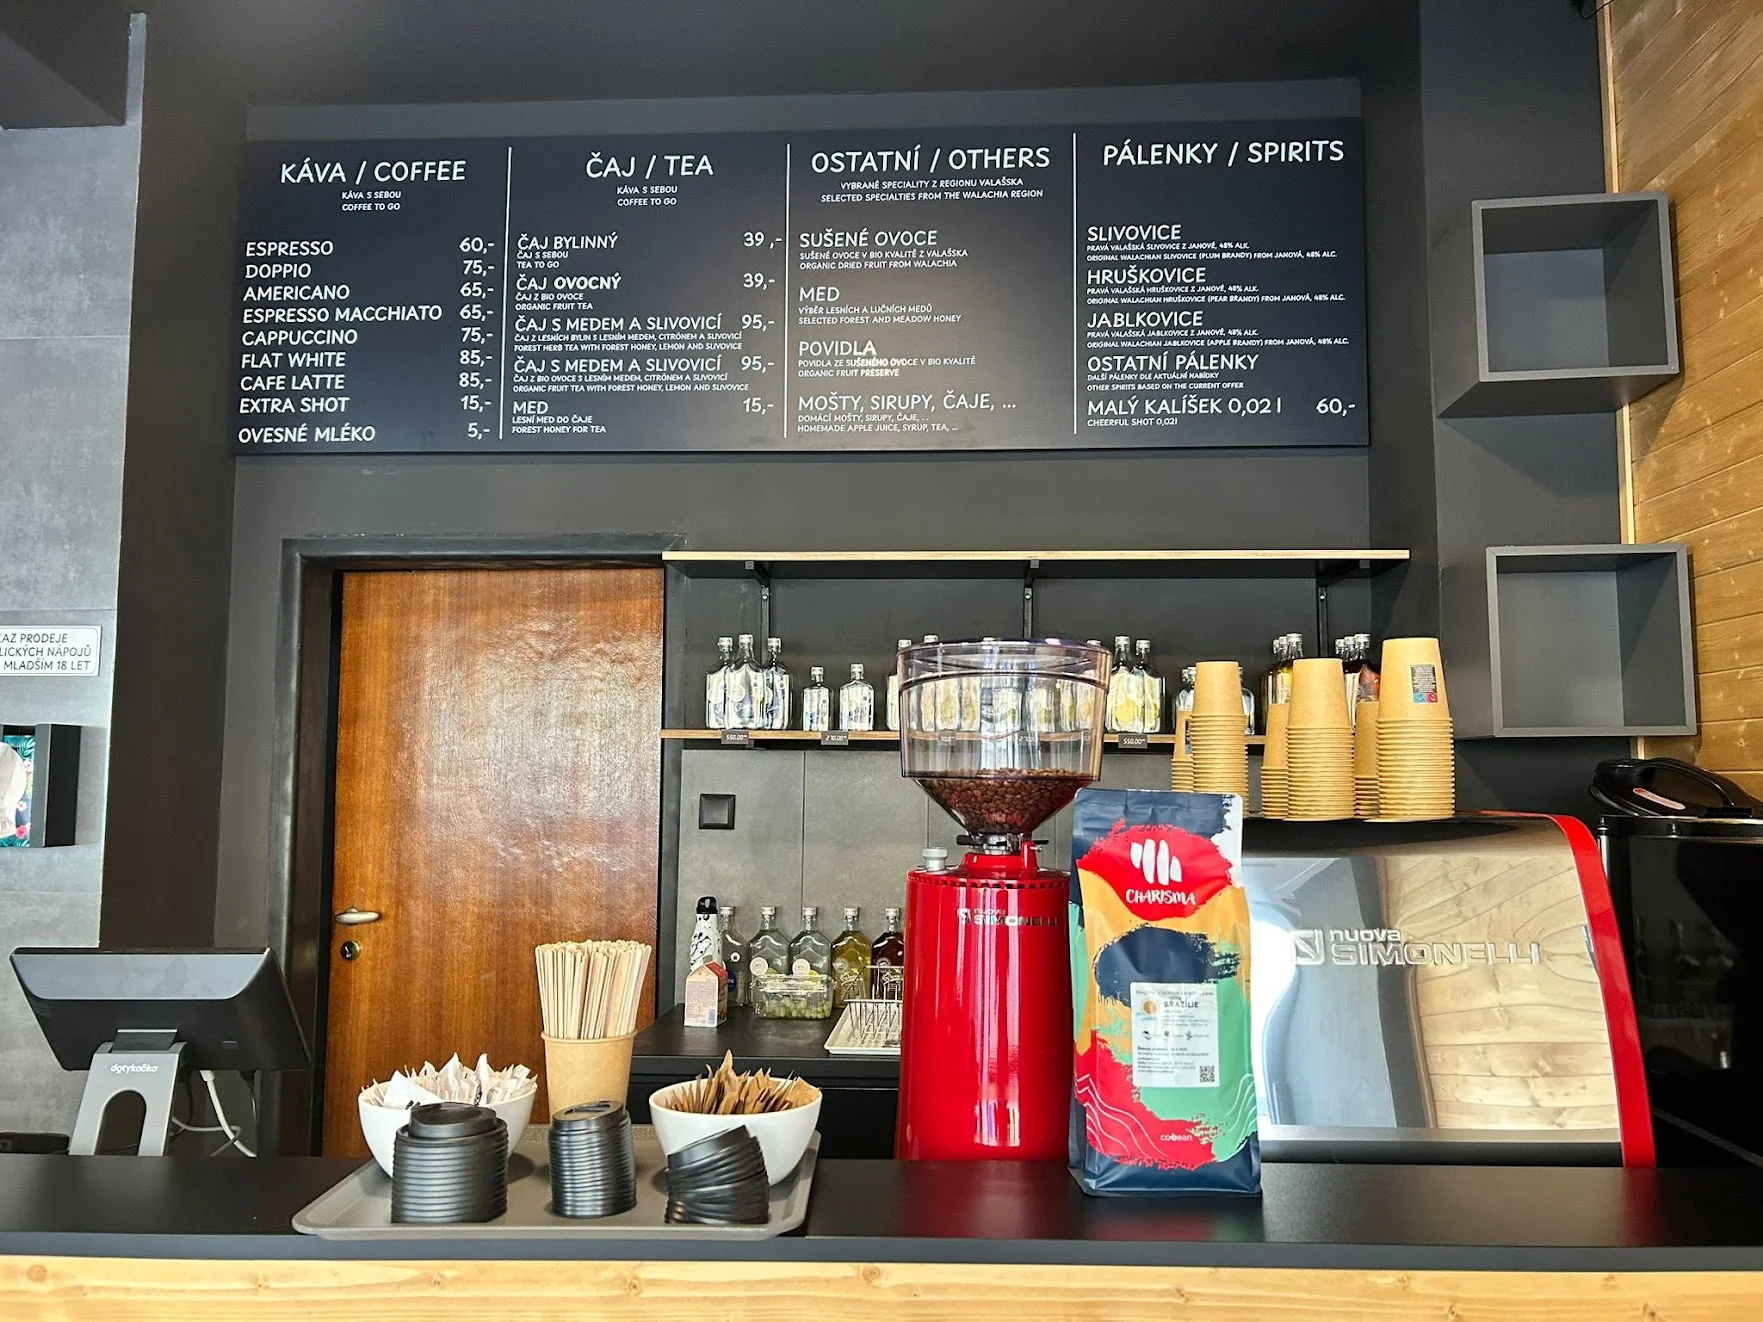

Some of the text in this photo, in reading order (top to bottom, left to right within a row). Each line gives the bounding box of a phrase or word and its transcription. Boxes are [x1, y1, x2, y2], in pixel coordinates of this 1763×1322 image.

[812, 145, 1050, 173] OSTATNÍ / OTHERS
[1104, 139, 1344, 166] PÁLENKY / SPIRITS
[281, 157, 466, 185] KÁVA / COFFEE
[586, 152, 713, 179] ČAJ / TEA
[617, 185, 678, 194] KÁVA S SEBOU
[841, 177, 1023, 190] VYBRANÉ SPECIALITY Z REGIONU VALAŠSKA
[342, 190, 401, 199] KÁVA S SEBOU
[617, 198, 648, 206] COFFEE
[663, 197, 677, 205] GO
[821, 190, 1043, 202] SELECTED SPECIALTIES FROM THE WALACHIA REGION
[342, 203, 372, 211] COFFEE
[518, 233, 548, 250] ČAJ
[553, 232, 618, 249] BYLINNÝ
[800, 227, 937, 248] SUŠENÉ OVOCE
[1088, 224, 1181, 241] SLIVOVICE
[246, 237, 495, 257] ESPRESSO 60,-
[517, 250, 568, 259] ČAJ S SEBOU
[245, 260, 495, 278] DOPPIO 75,-
[516, 261, 532, 269] TEA
[799, 260, 957, 270] ORGANIC DRIED FRUIT FROM WALACHIA
[516, 272, 775, 291] ČAJ OVOCNÝ 39,-
[1088, 265, 1206, 285] HRUŠKOVICE
[243, 282, 494, 301] AMERICANO 65,-
[799, 286, 840, 302] MED
[243, 304, 494, 323] ESPRESSO MACCHIATO 65,-
[515, 303, 551, 311] ORGANIC
[577, 302, 593, 310] TEA
[515, 312, 775, 332] ČAJ S MEDEM A SLIVOVICÍ 95,-
[1087, 311, 1203, 328] JABLKOVICE
[242, 327, 493, 346] CAPPUCCINO 75,-
[799, 340, 877, 356] POVIDLA
[242, 349, 493, 369] FLAT WHITE 85,-
[514, 354, 774, 373] ČAJ S MEDEM A SLIVOVICÍ 95,-
[1088, 350, 1259, 372] OSTATNÍ PÁLENKY
[240, 372, 492, 391] CAFE LATTE 85,-
[798, 368, 900, 377] ORGANIC FRUIT PRESERVE
[1111, 383, 1136, 391] SPIRITS
[239, 395, 492, 413] EXTRA SHOT 15,-
[513, 397, 774, 415] MED 15,-
[798, 391, 864, 414] MOŠTY,
[870, 394, 935, 413] SIRUPY,
[943, 390, 994, 411] ČAJE,
[1088, 396, 1139, 416] MALÝ
[1145, 395, 1222, 415] KALÍŠEK
[1228, 398, 1272, 416] 0,02
[1316, 398, 1355, 416] 60,-
[512, 415, 593, 424] LESNÍ MED DO ČAJE
[1087, 418, 1129, 427] CHEERFUL
[1131, 418, 1155, 426] SHOT
[238, 422, 490, 443] OVESNÉ MLÉKO 5,-
[589, 425, 606, 433] TEA
[20, 633, 68, 643] PRODEJE
[47, 644, 91, 656] NÁPOJŮ
[4, 658, 91, 670] MLADŠÍM 18 LET
[1125, 888, 1197, 906] CHARISMA
[1329, 929, 1401, 942] nuova
[1331, 942, 1541, 965] SIMONELLI
[110, 1063, 159, 1074] dotykačka
